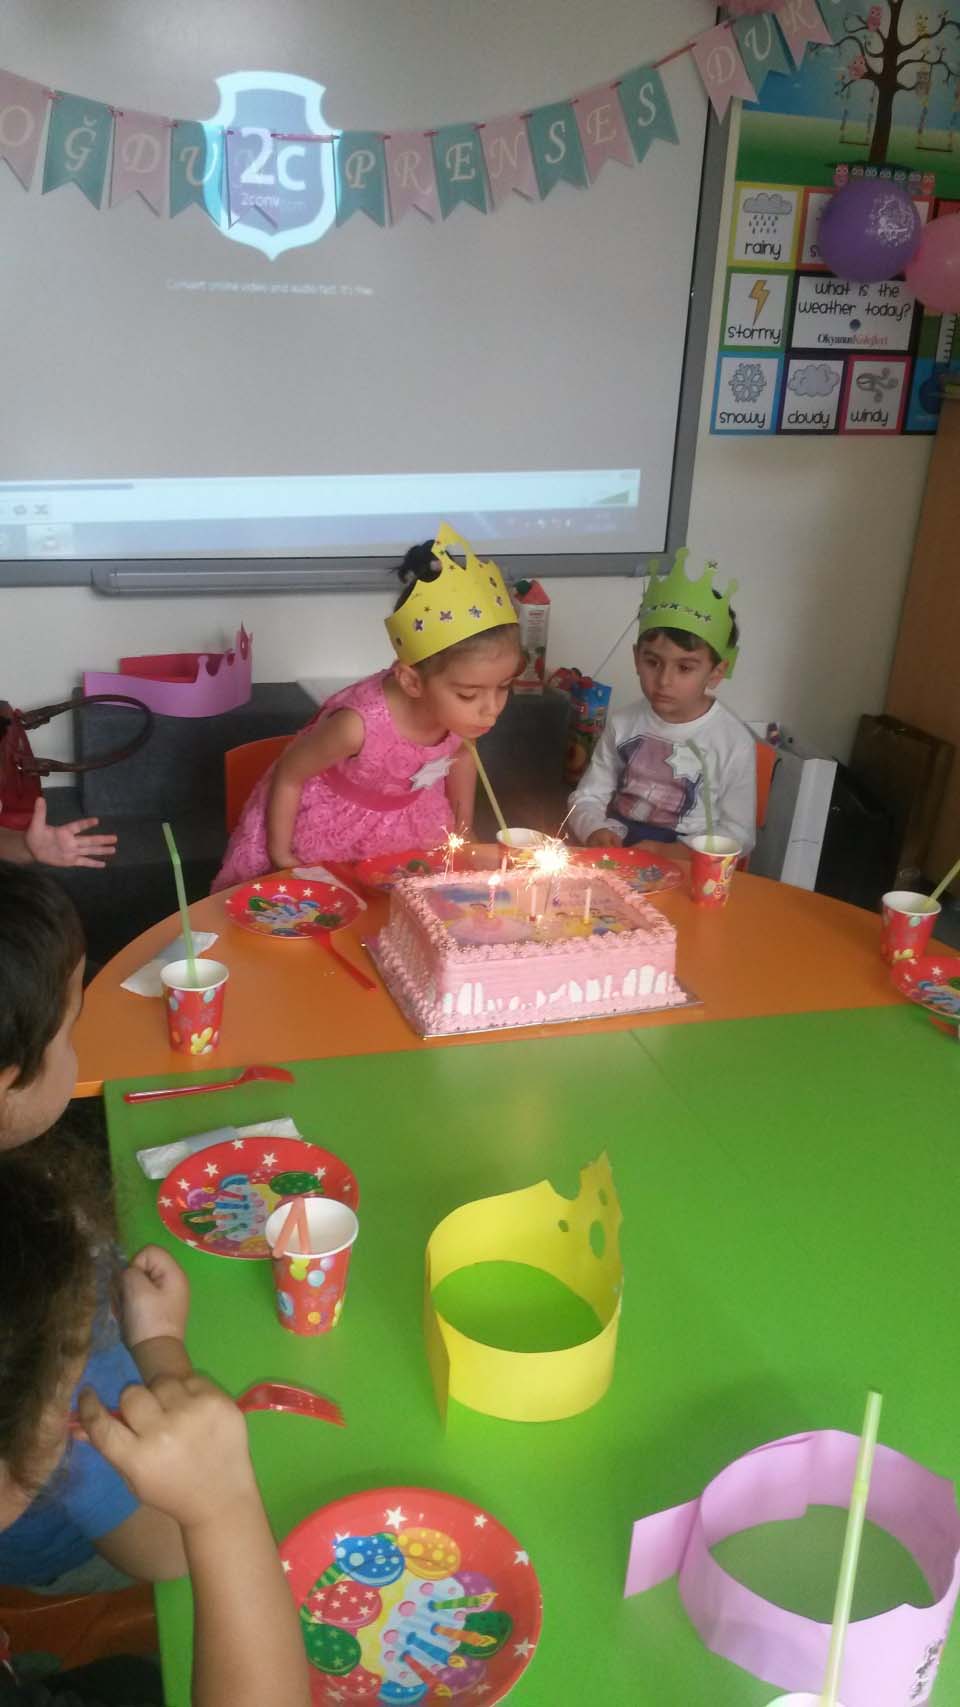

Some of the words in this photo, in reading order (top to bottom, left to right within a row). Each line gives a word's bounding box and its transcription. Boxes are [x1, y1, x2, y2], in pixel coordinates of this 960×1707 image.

[707, 0, 840, 83] DUR
[344, 81, 657, 197] PRENSES
[744, 240, 782, 260] rainy
[815, 280, 850, 295] what
[859, 283, 870, 296] is
[878, 283, 900, 298] the
[798, 299, 857, 316] weather
[865, 302, 912, 321] today?
[728, 324, 781, 344] stormy
[719, 411, 766, 428] snowy
[787, 410, 830, 428] cloudy
[850, 409, 889, 426] windy
